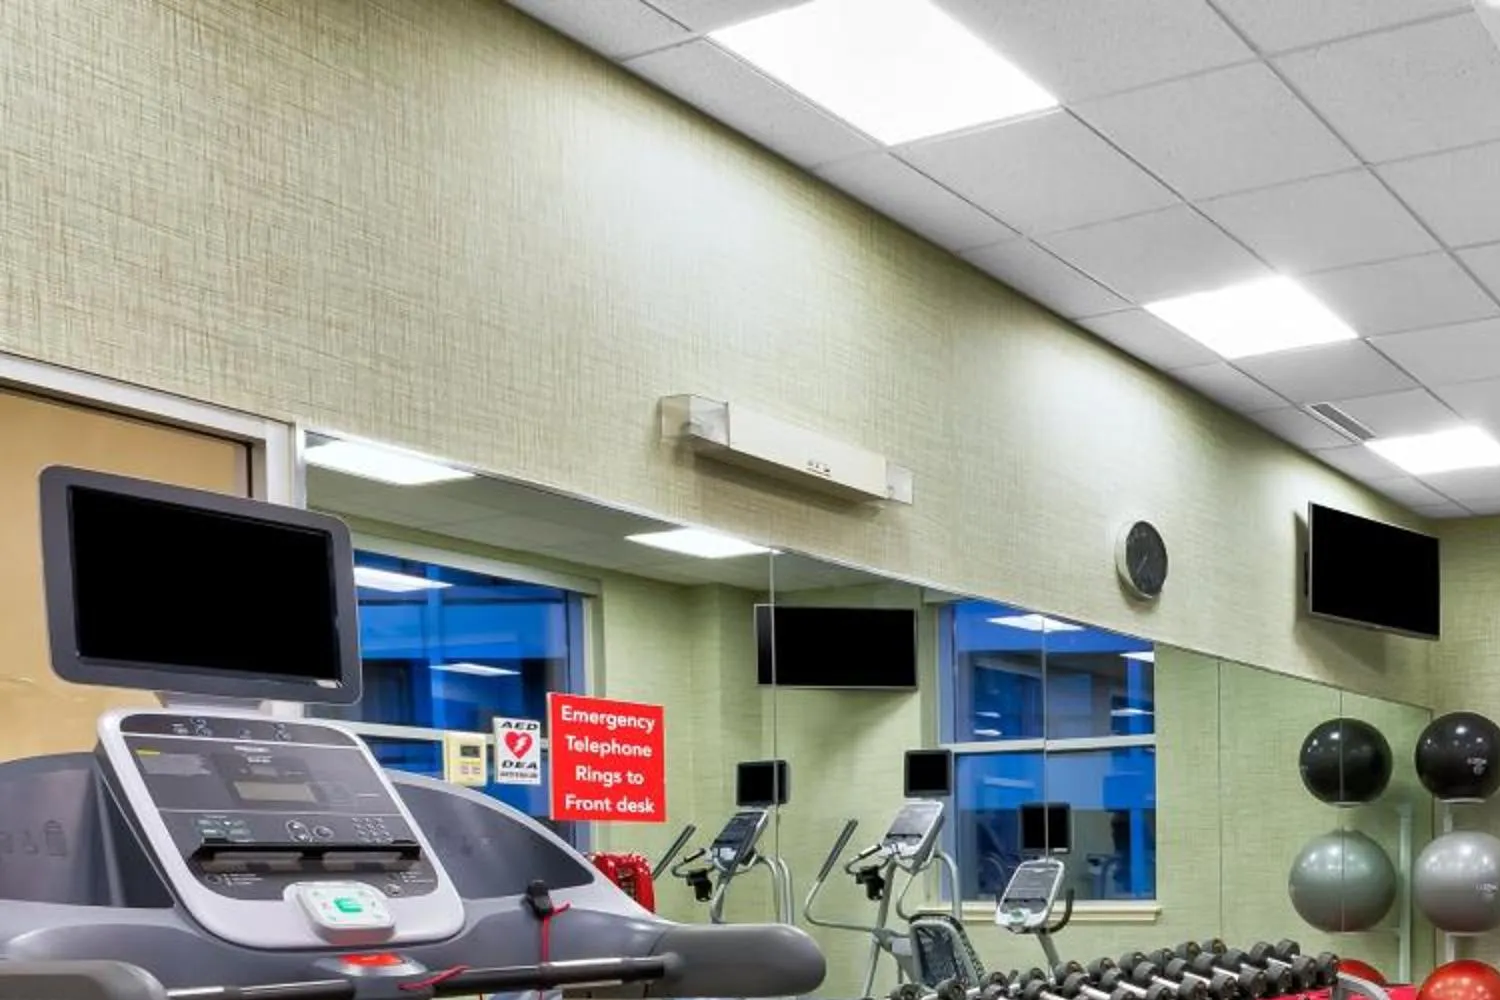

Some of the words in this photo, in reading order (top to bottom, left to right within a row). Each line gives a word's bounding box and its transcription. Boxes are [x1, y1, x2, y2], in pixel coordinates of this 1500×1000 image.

[501, 721, 538, 731] AED
[561, 705, 655, 735] Emergency
[565, 734, 653, 758] Telephone
[502, 760, 538, 769] DEA
[575, 765, 622, 787] Rings
[626, 771, 645, 785] to
[565, 794, 612, 813] Front
[616, 796, 655, 813] desk
